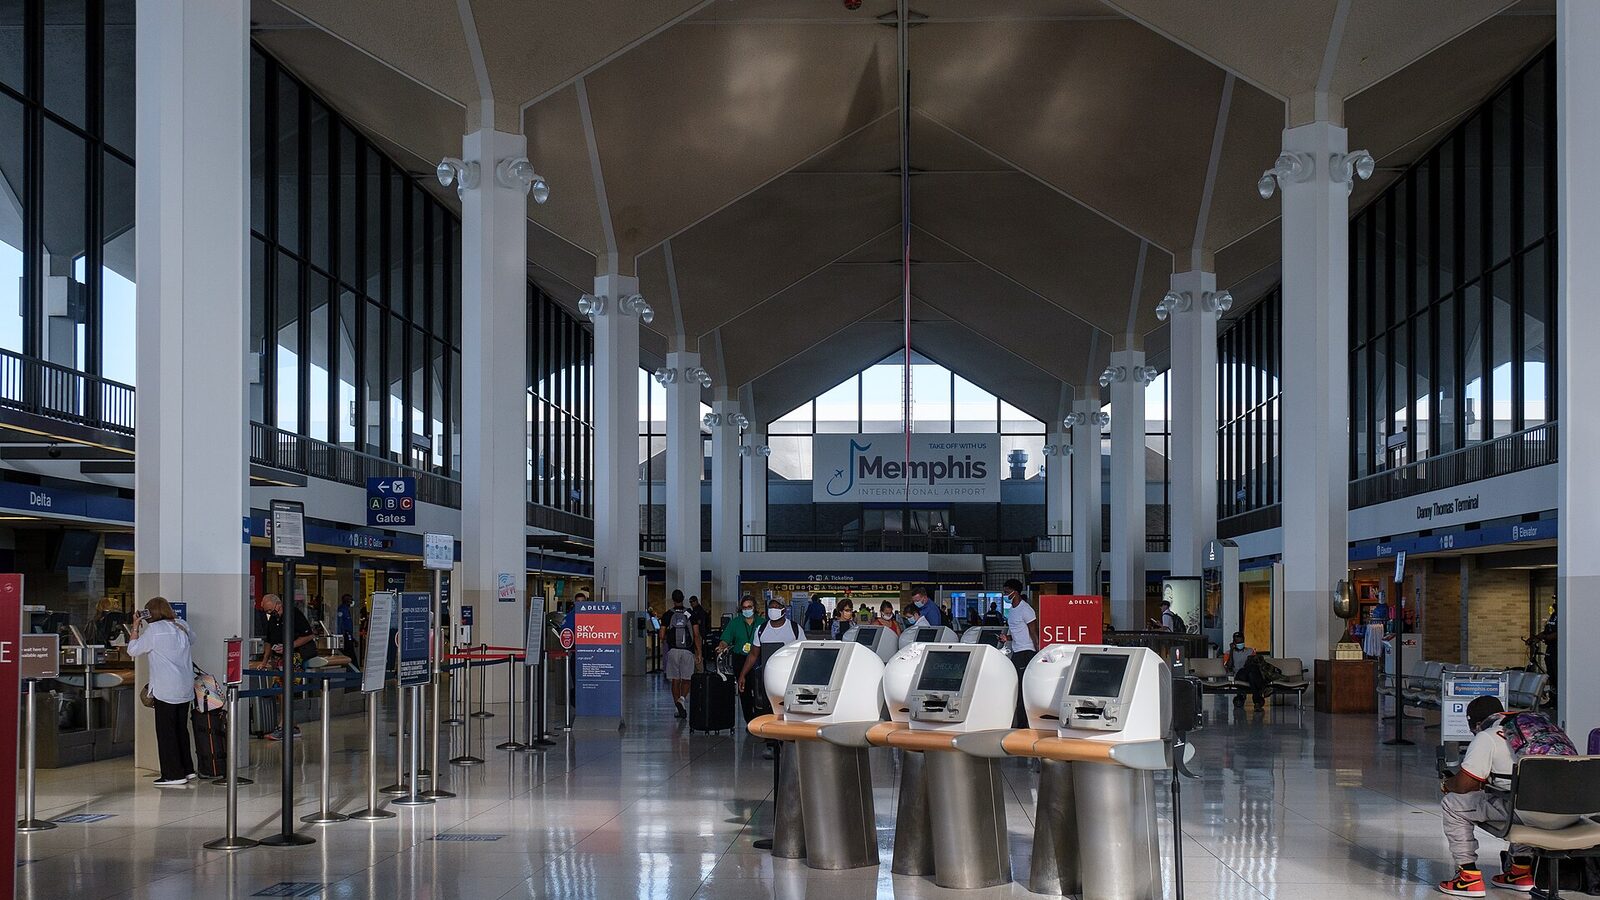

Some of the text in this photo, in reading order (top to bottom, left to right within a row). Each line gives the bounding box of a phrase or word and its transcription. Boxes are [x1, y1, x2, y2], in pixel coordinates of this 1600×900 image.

[858, 455, 987, 485] Memphis
[30, 492, 51, 506] Delta
[372, 500, 410, 508] A B C
[1417, 494, 1479, 520] Danny Thomas Terminal
[376, 514, 406, 522] Gates
[1520, 527, 1537, 537] Elevator
[1043, 626, 1087, 642] SELF
